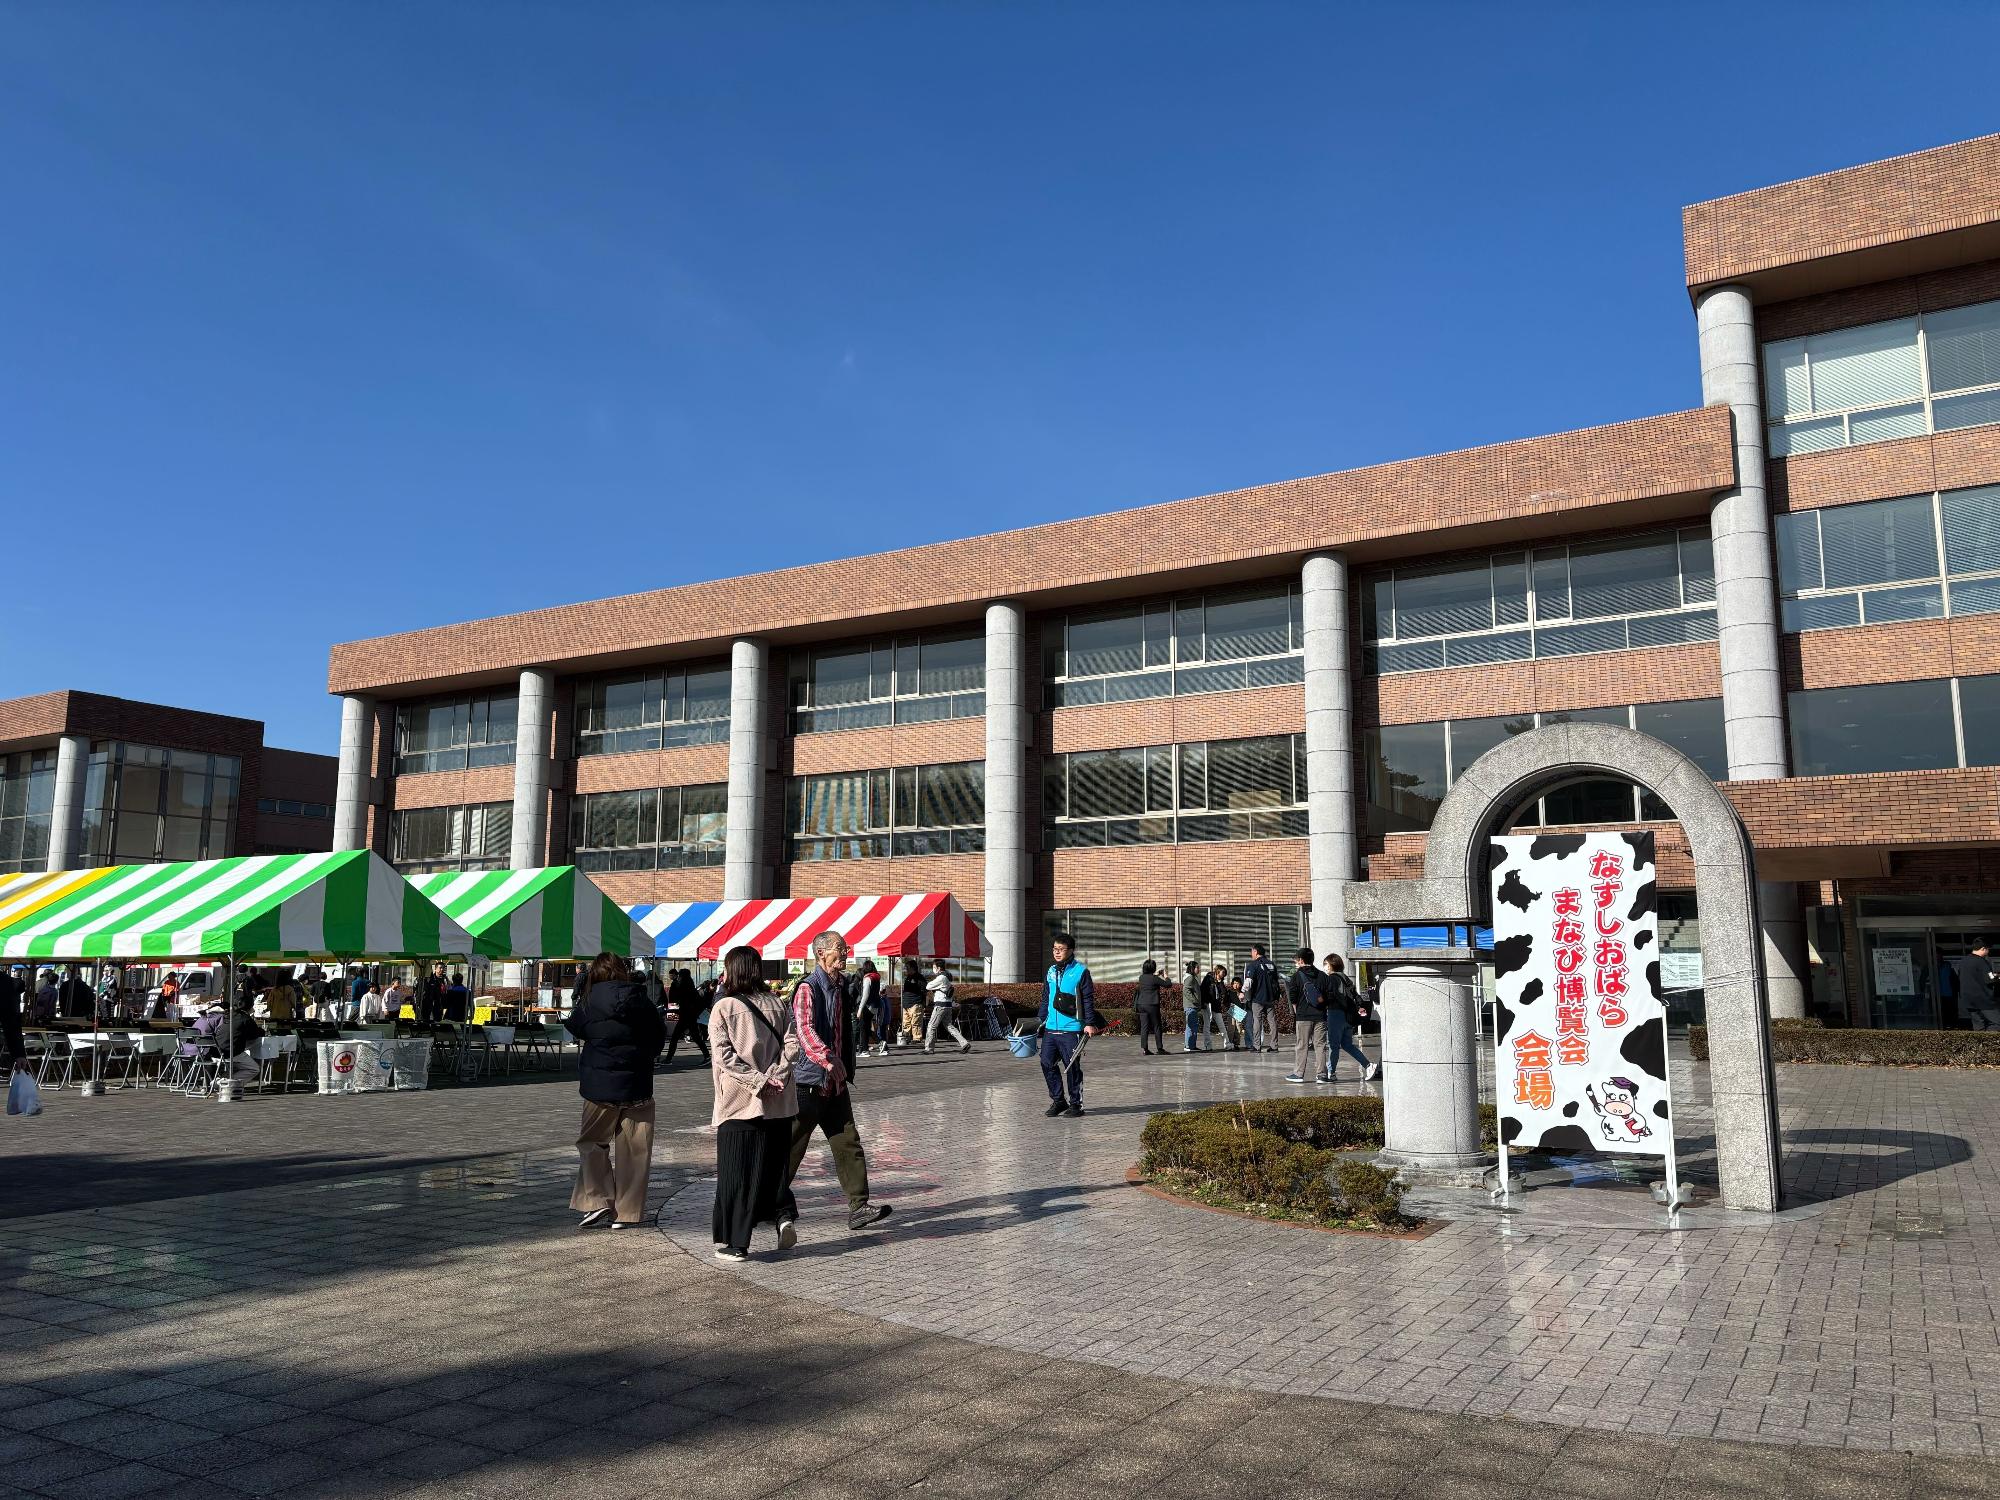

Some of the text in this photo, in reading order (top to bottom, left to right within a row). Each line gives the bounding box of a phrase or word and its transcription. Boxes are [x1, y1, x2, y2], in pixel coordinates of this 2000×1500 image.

[1552, 887, 1590, 1066] まなび博覧会
[1588, 850, 1629, 1029] なすしおばら
[1512, 1029, 1556, 1111] 会場
